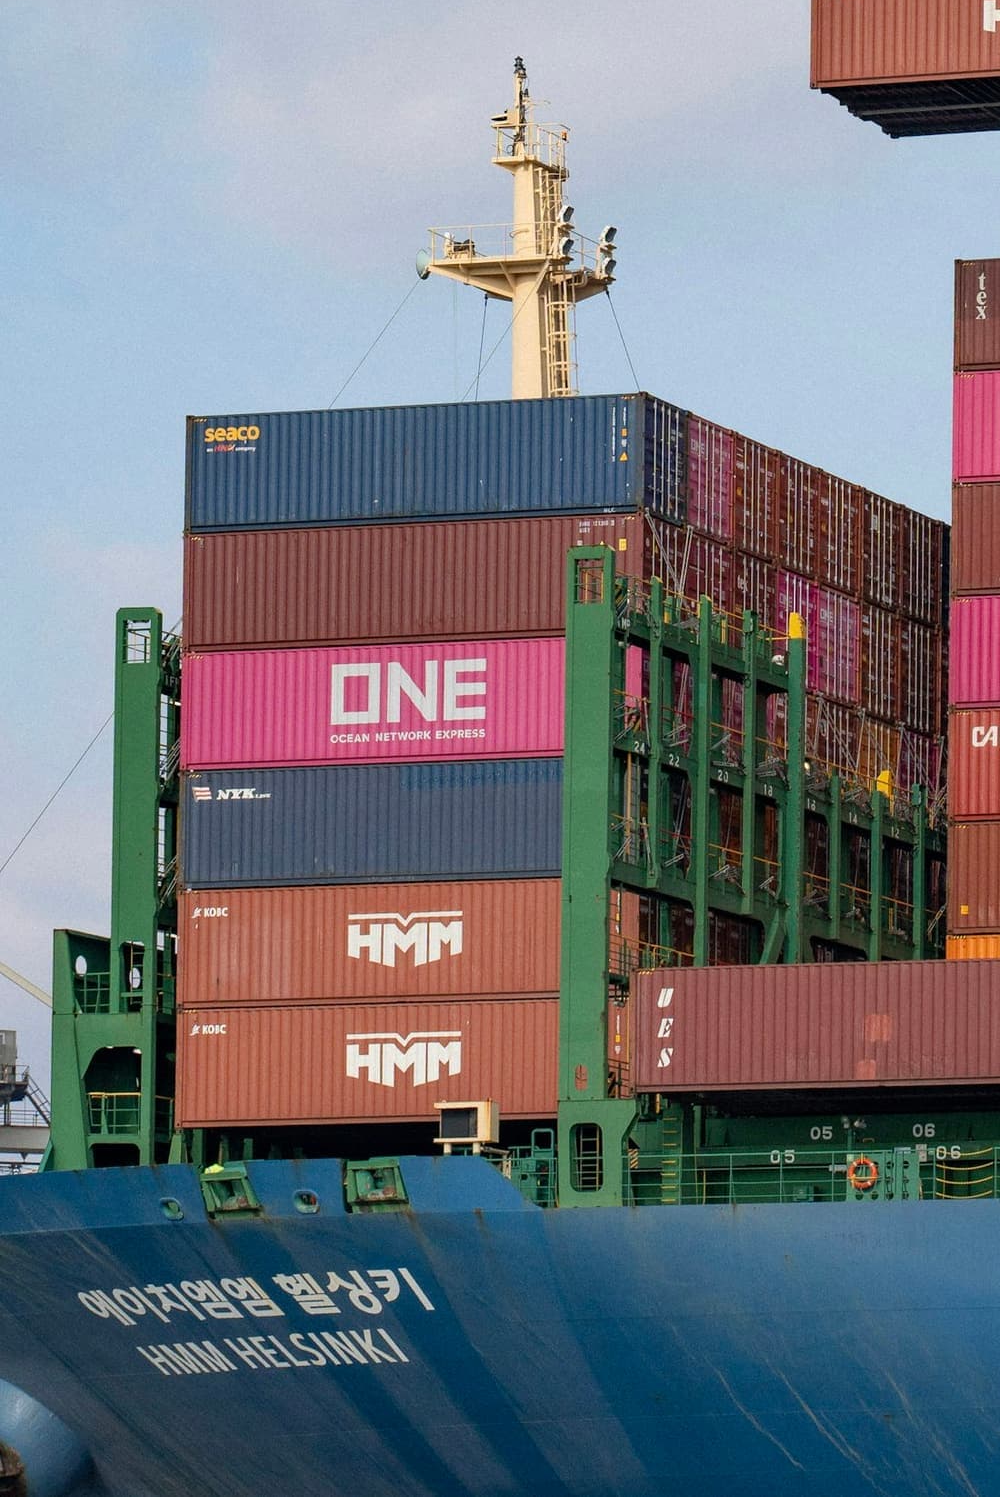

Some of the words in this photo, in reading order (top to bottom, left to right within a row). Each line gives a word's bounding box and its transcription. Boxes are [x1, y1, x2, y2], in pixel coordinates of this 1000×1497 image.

[976, 273, 987, 320] tex
[204, 426, 260, 442] seaco
[331, 658, 486, 725] ONE
[330, 733, 370, 744] OCEAN
[375, 731, 431, 742] NETWORK
[435, 728, 486, 740] EXPRESS
[634, 741, 646, 753] 24
[669, 754, 681, 767] 22
[717, 770, 729, 783] 20
[216, 788, 256, 800] NYK
[203, 907, 228, 917] KOBC
[347, 910, 463, 967] HMM
[202, 1024, 226, 1035] KOBC
[346, 1030, 461, 1087] HMM
[810, 1126, 833, 1140] 05
[912, 1123, 935, 1138] 06
[770, 1150, 795, 1164] 05
[935, 1145, 961, 1160] 06
[78, 1277, 285, 1326] 에이치엠엠
[271, 1268, 435, 1316] 헬싱키
[137, 1339, 238, 1376] HMM
[223, 1328, 410, 1370] HELSINKI
